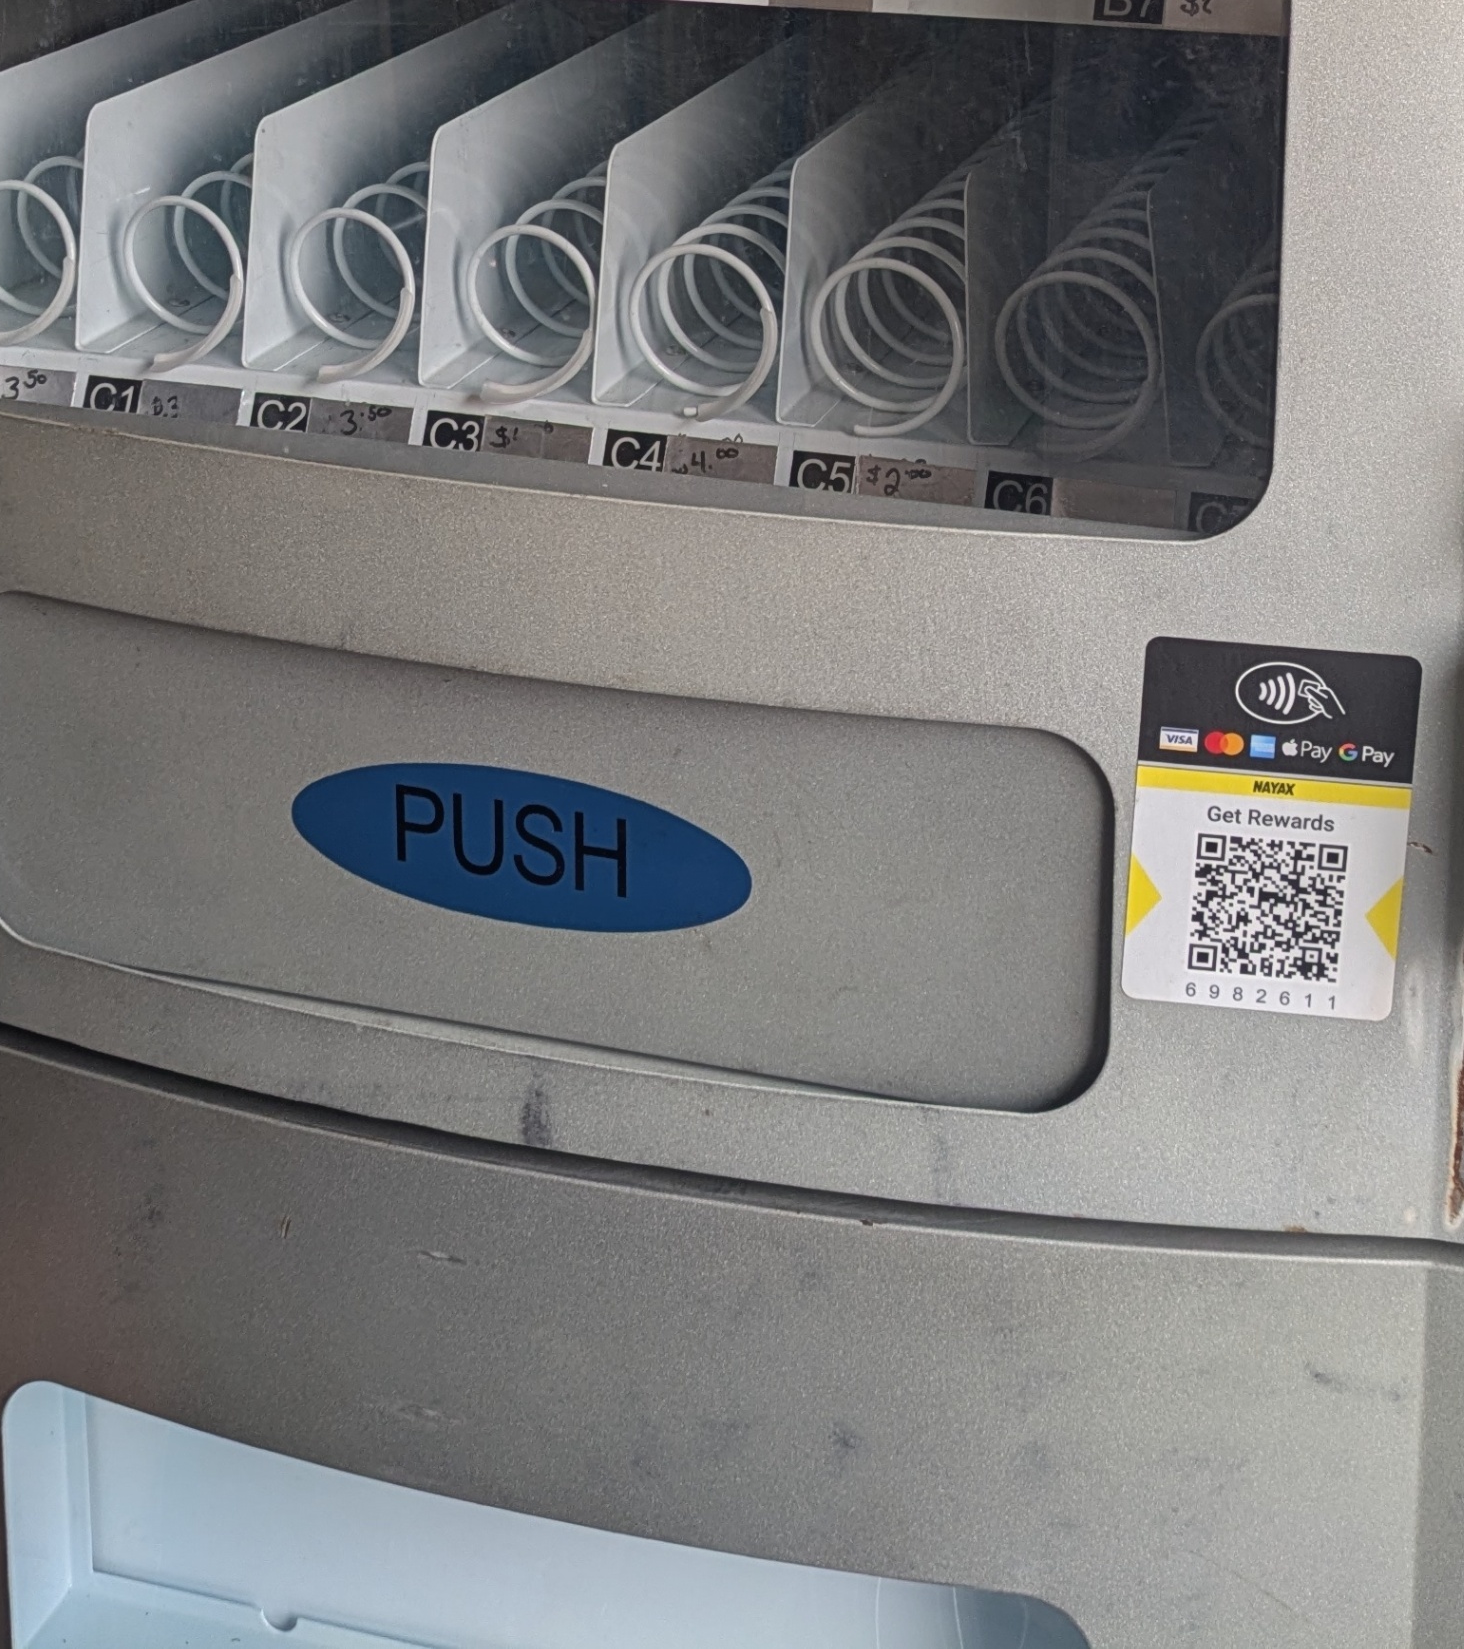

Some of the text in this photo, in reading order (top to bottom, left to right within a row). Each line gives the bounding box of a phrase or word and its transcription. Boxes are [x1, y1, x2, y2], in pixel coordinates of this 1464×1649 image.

[89, 382, 136, 414] C1
[256, 399, 307, 433] C2
[429, 417, 482, 452] C3
[610, 436, 662, 472] C4
[796, 458, 851, 493] C5
[992, 480, 1049, 516] C6
[1165, 733, 1193, 746] VISA
[1300, 740, 1333, 763] Pay
[1361, 746, 1396, 768] Pay
[1252, 780, 1296, 796] NAYAX
[1207, 805, 1335, 833] Get Rewards
[395, 783, 628, 899] PUSH
